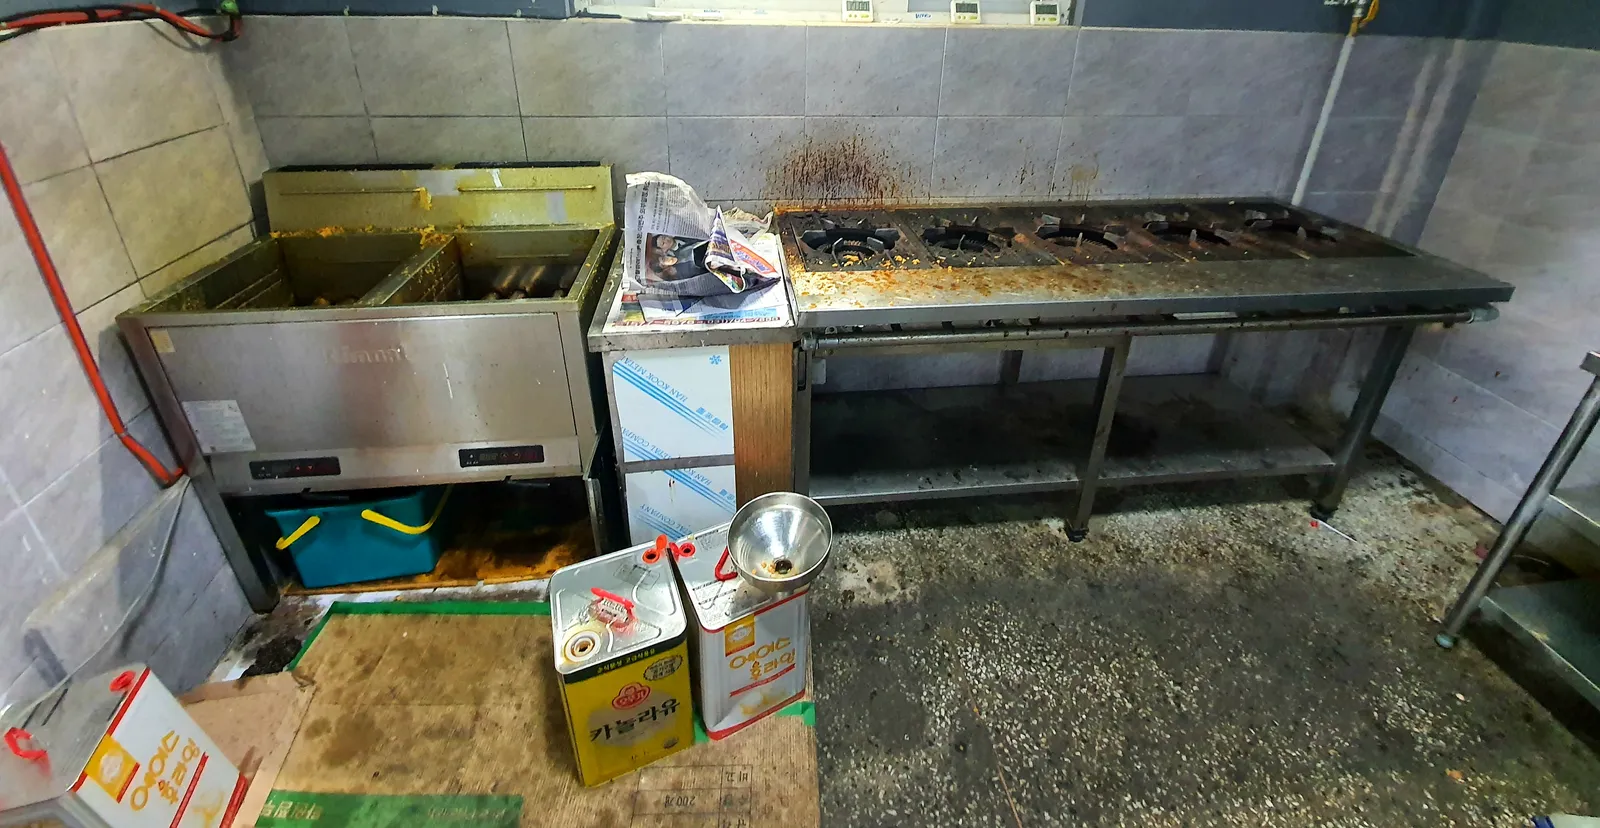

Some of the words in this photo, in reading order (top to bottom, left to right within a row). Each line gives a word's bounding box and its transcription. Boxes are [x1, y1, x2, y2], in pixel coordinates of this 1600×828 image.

[646, 373, 670, 392] KOOK
[621, 426, 650, 448] COMPA
[729, 636, 792, 670] 에이스
[589, 698, 680, 743] 카놀라유
